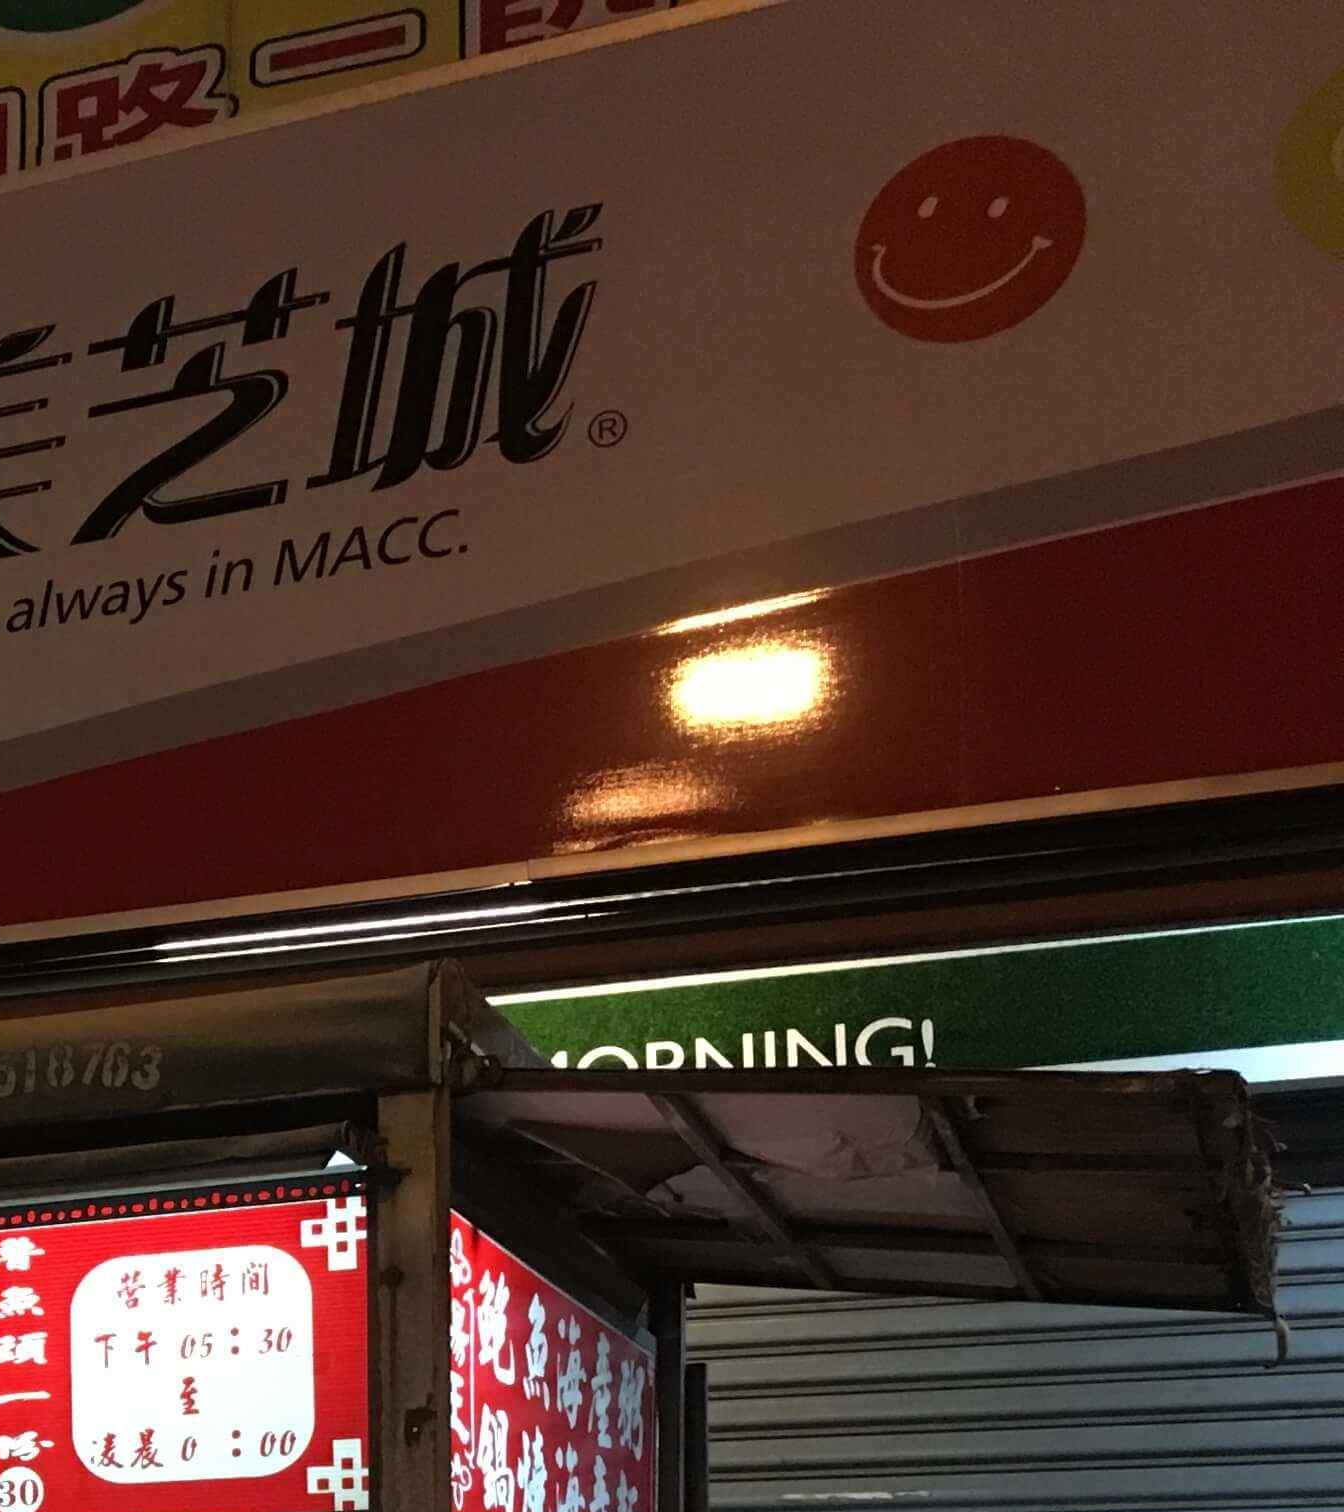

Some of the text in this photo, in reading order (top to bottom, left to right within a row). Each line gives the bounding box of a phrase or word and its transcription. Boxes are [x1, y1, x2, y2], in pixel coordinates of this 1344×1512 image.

[4, 570, 190, 642] always
[205, 550, 255, 599] in
[272, 510, 471, 584] MACC.
[550, 1016, 936, 1069] RNING!
[117, 1262, 271, 1309] 營業時間
[94, 1331, 158, 1368] 下午
[476, 1268, 646, 1462] 鮑魚海產粥
[180, 1376, 200, 1416] 至
